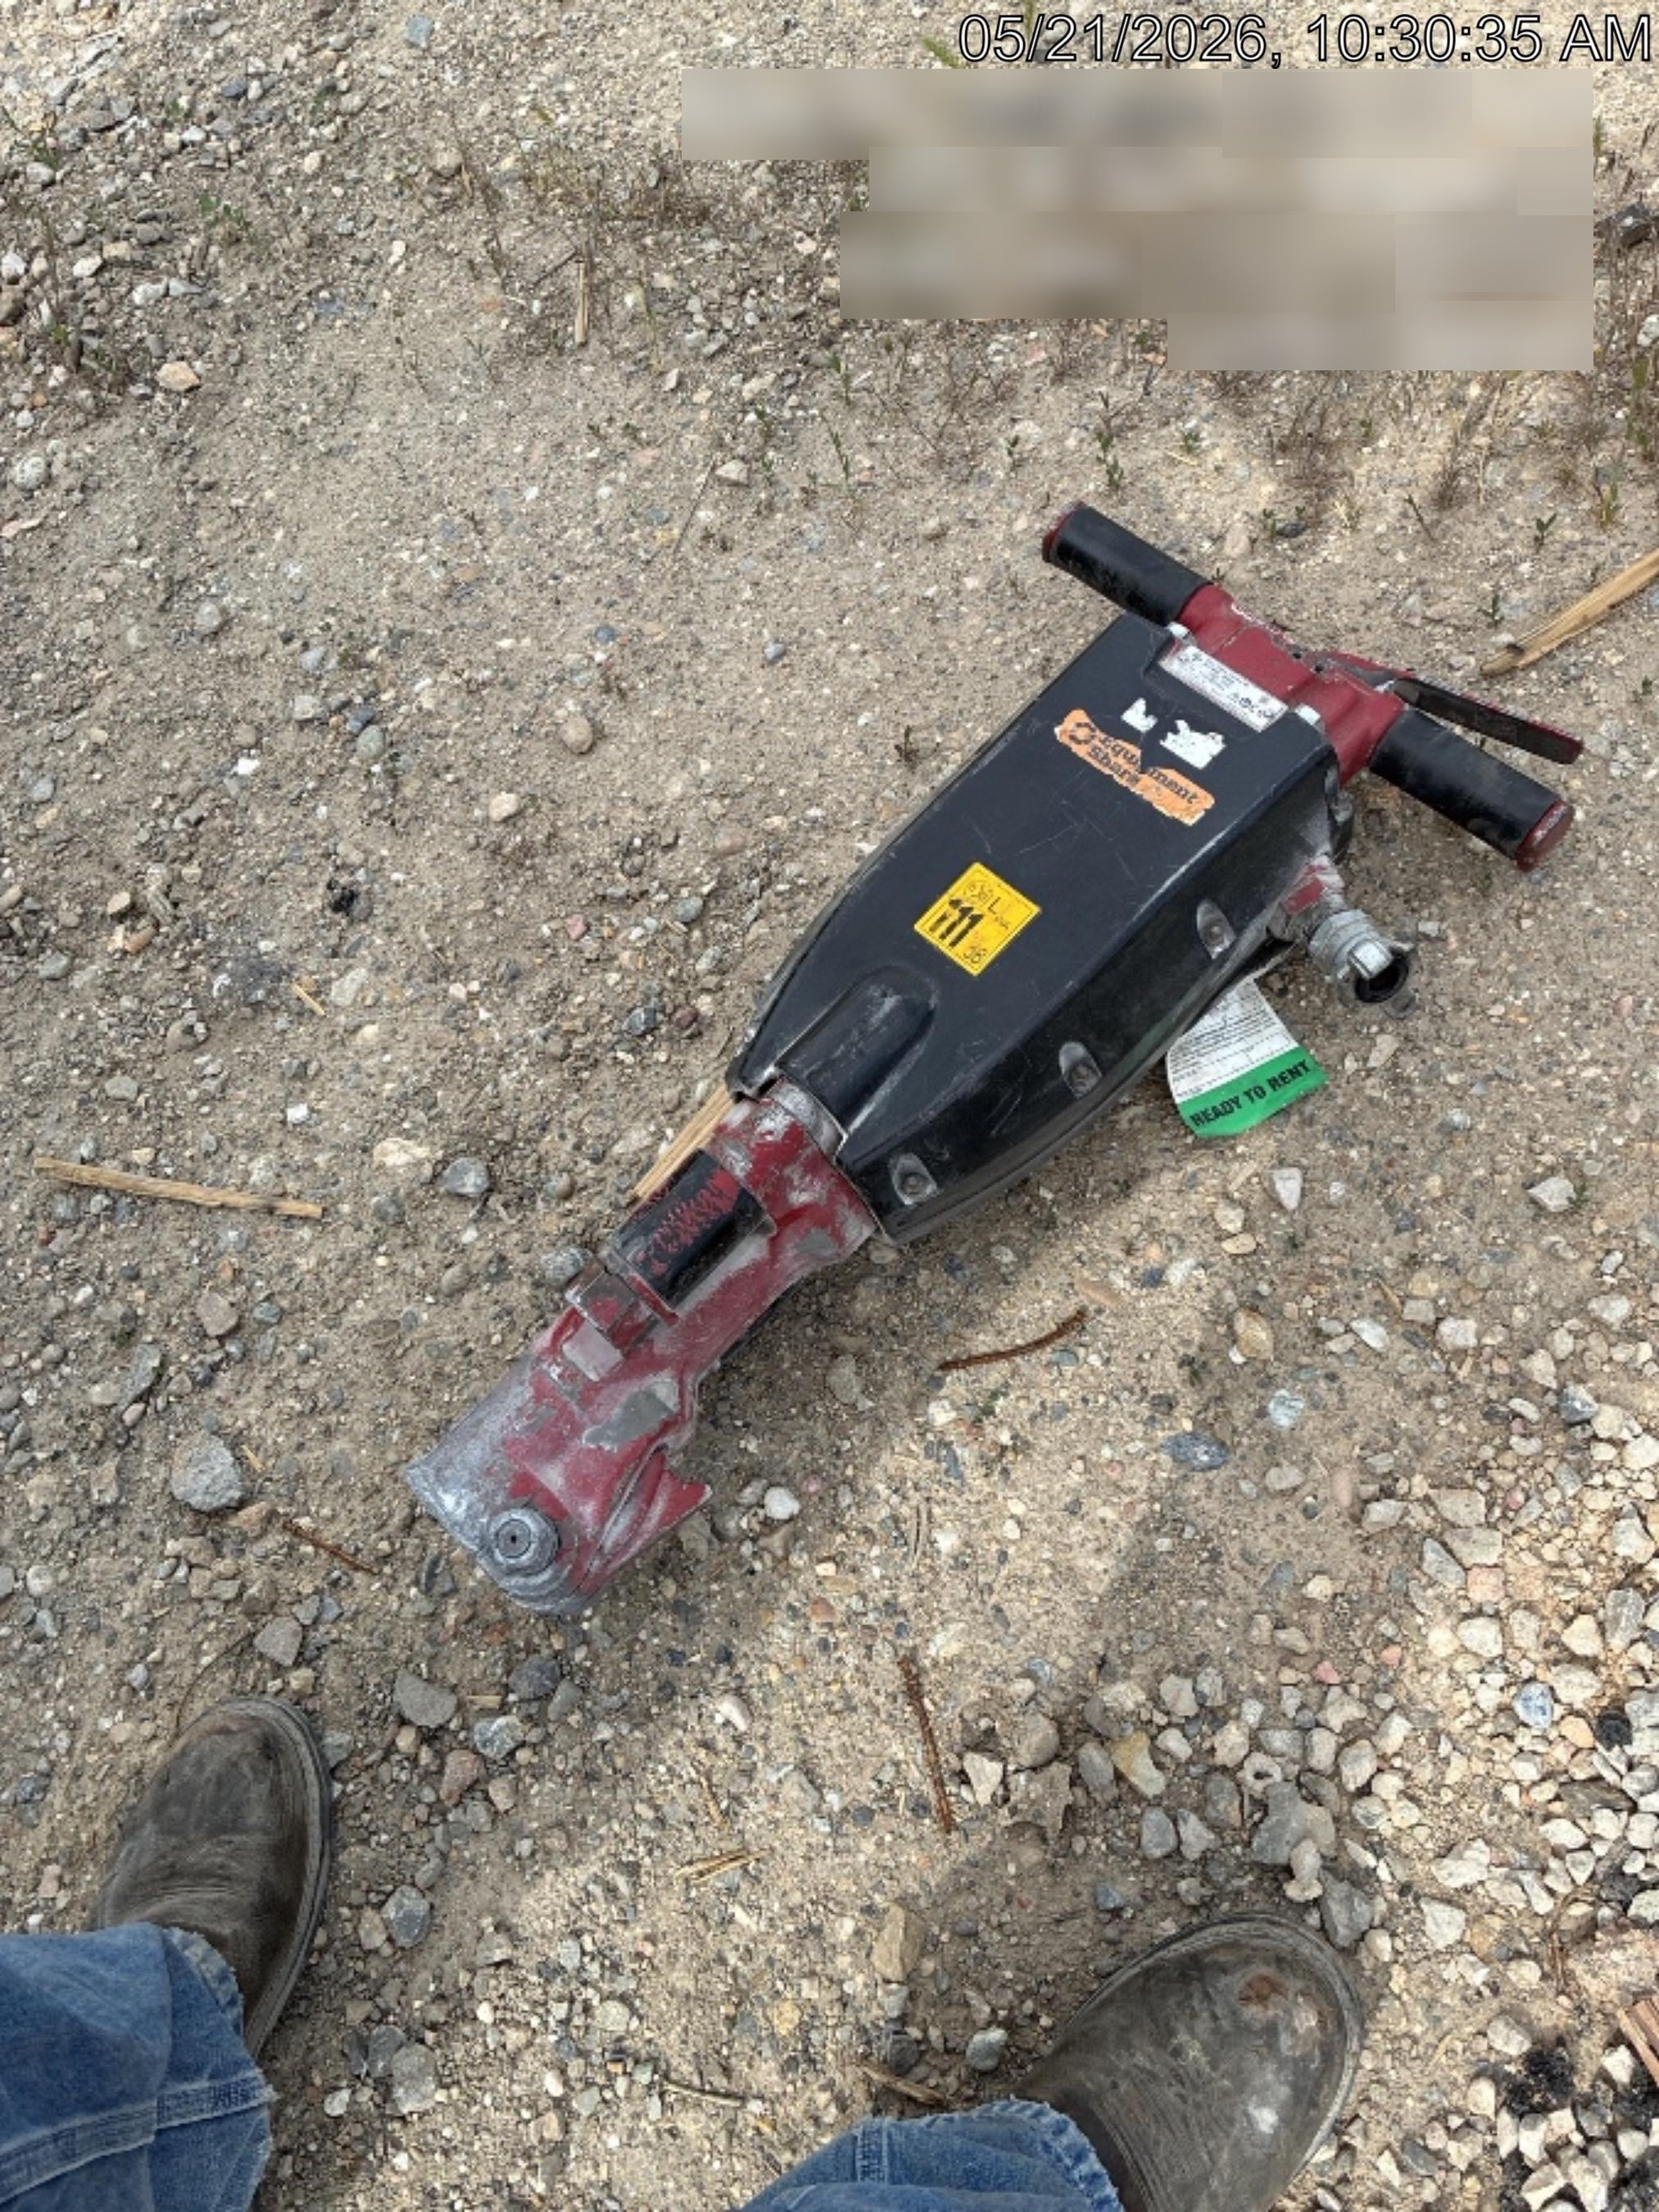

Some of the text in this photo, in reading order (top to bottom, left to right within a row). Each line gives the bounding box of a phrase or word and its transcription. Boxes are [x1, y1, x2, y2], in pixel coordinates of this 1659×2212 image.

[1087, 745, 1141, 786] Share
[1099, 737, 1198, 805] Equiment
[928, 899, 985, 949] 111
[1190, 1059, 1311, 1127] READY TO RENT
